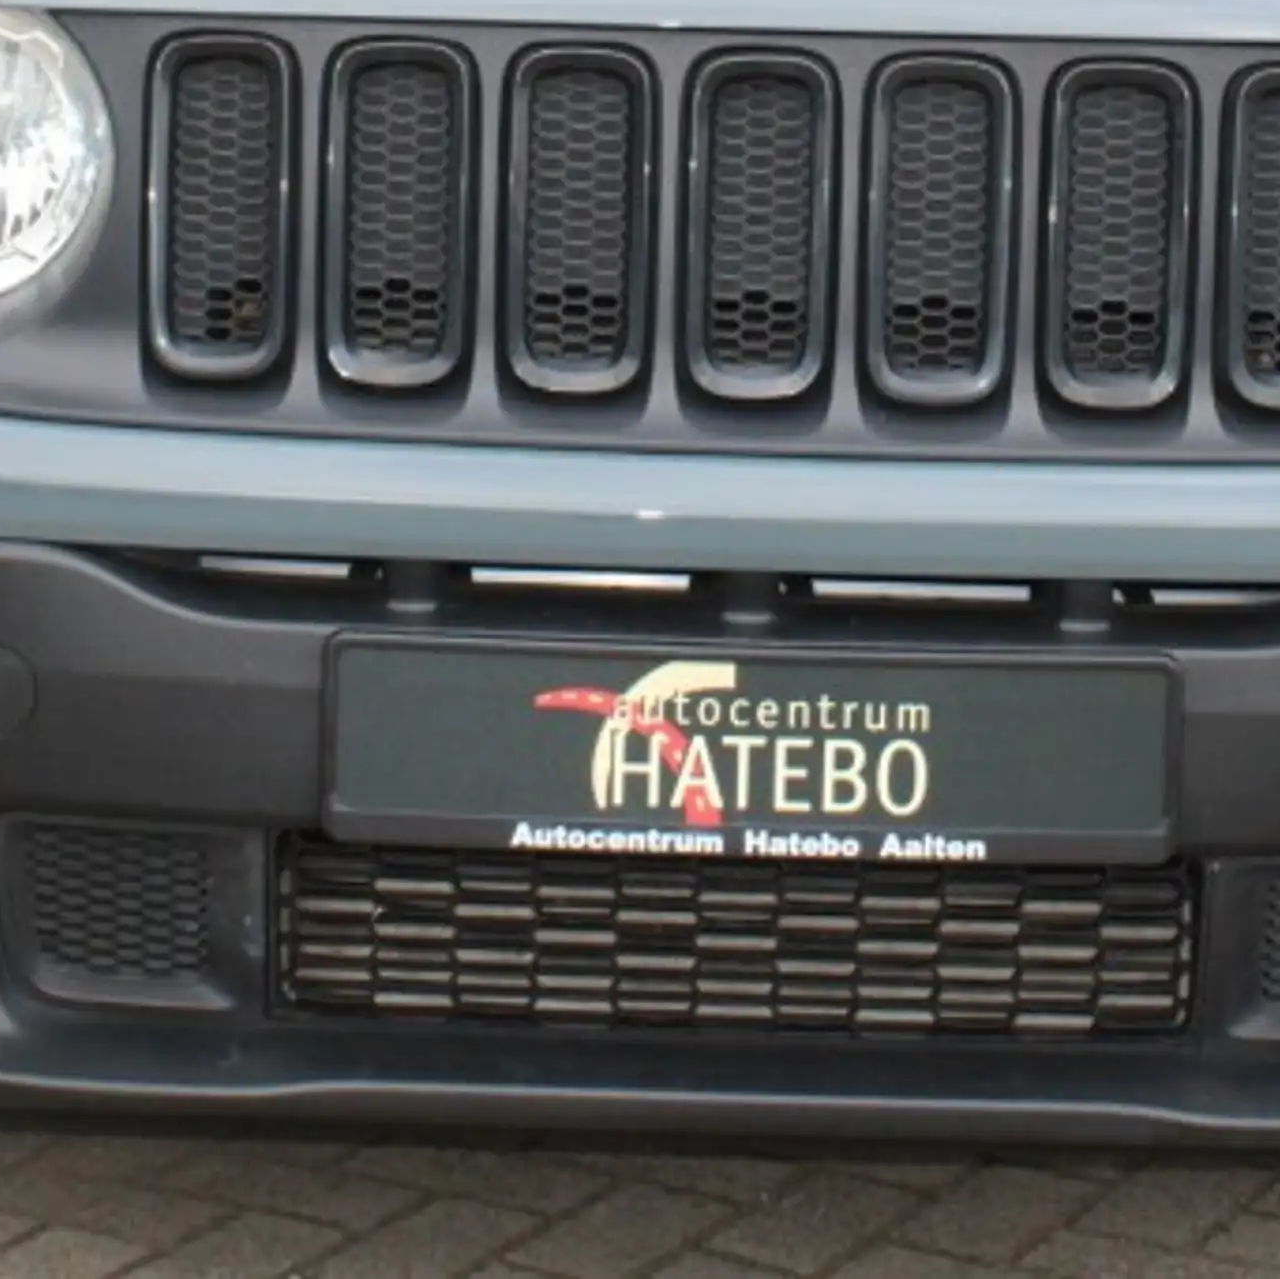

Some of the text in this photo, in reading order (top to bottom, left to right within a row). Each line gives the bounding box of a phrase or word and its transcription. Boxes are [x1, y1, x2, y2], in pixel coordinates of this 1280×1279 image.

[613, 689, 930, 733] autocentrum
[611, 735, 928, 816] HATEBO
[511, 822, 987, 861] Autocentrum Hatebo Aalten
